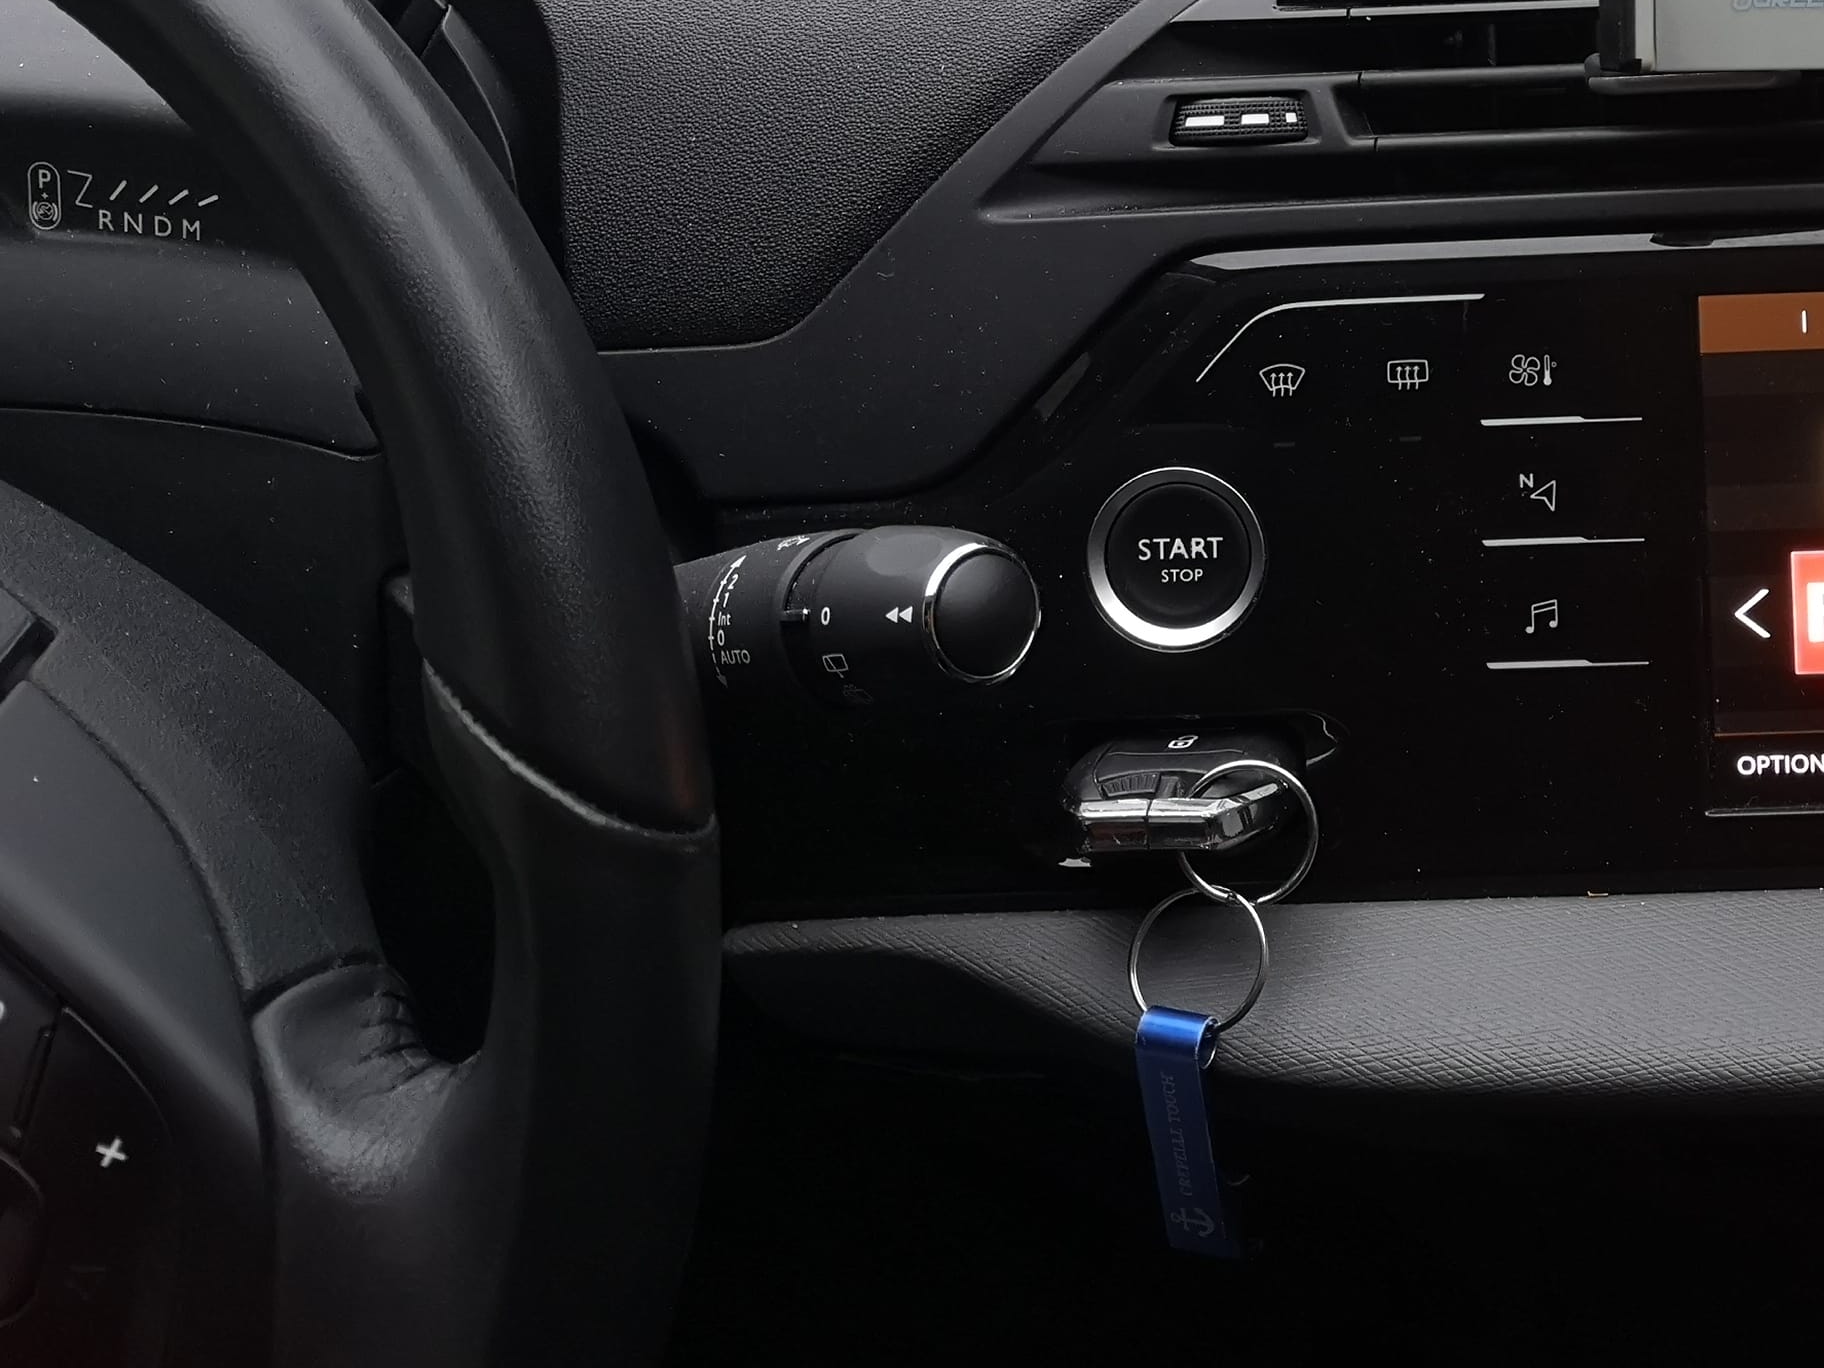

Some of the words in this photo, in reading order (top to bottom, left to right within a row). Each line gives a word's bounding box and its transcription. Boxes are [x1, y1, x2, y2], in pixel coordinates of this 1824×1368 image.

[38, 169, 51, 189] P
[98, 209, 114, 231] R
[123, 212, 143, 234] N
[154, 215, 172, 237] D
[182, 218, 201, 241] M
[1519, 473, 1533, 488] N
[1137, 536, 1224, 561] START
[727, 573, 740, 590] 2
[1161, 569, 1204, 583] STOP
[717, 612, 732, 627] Int
[820, 607, 831, 626] 0
[717, 630, 726, 646] 0
[720, 648, 751, 665] AUTO
